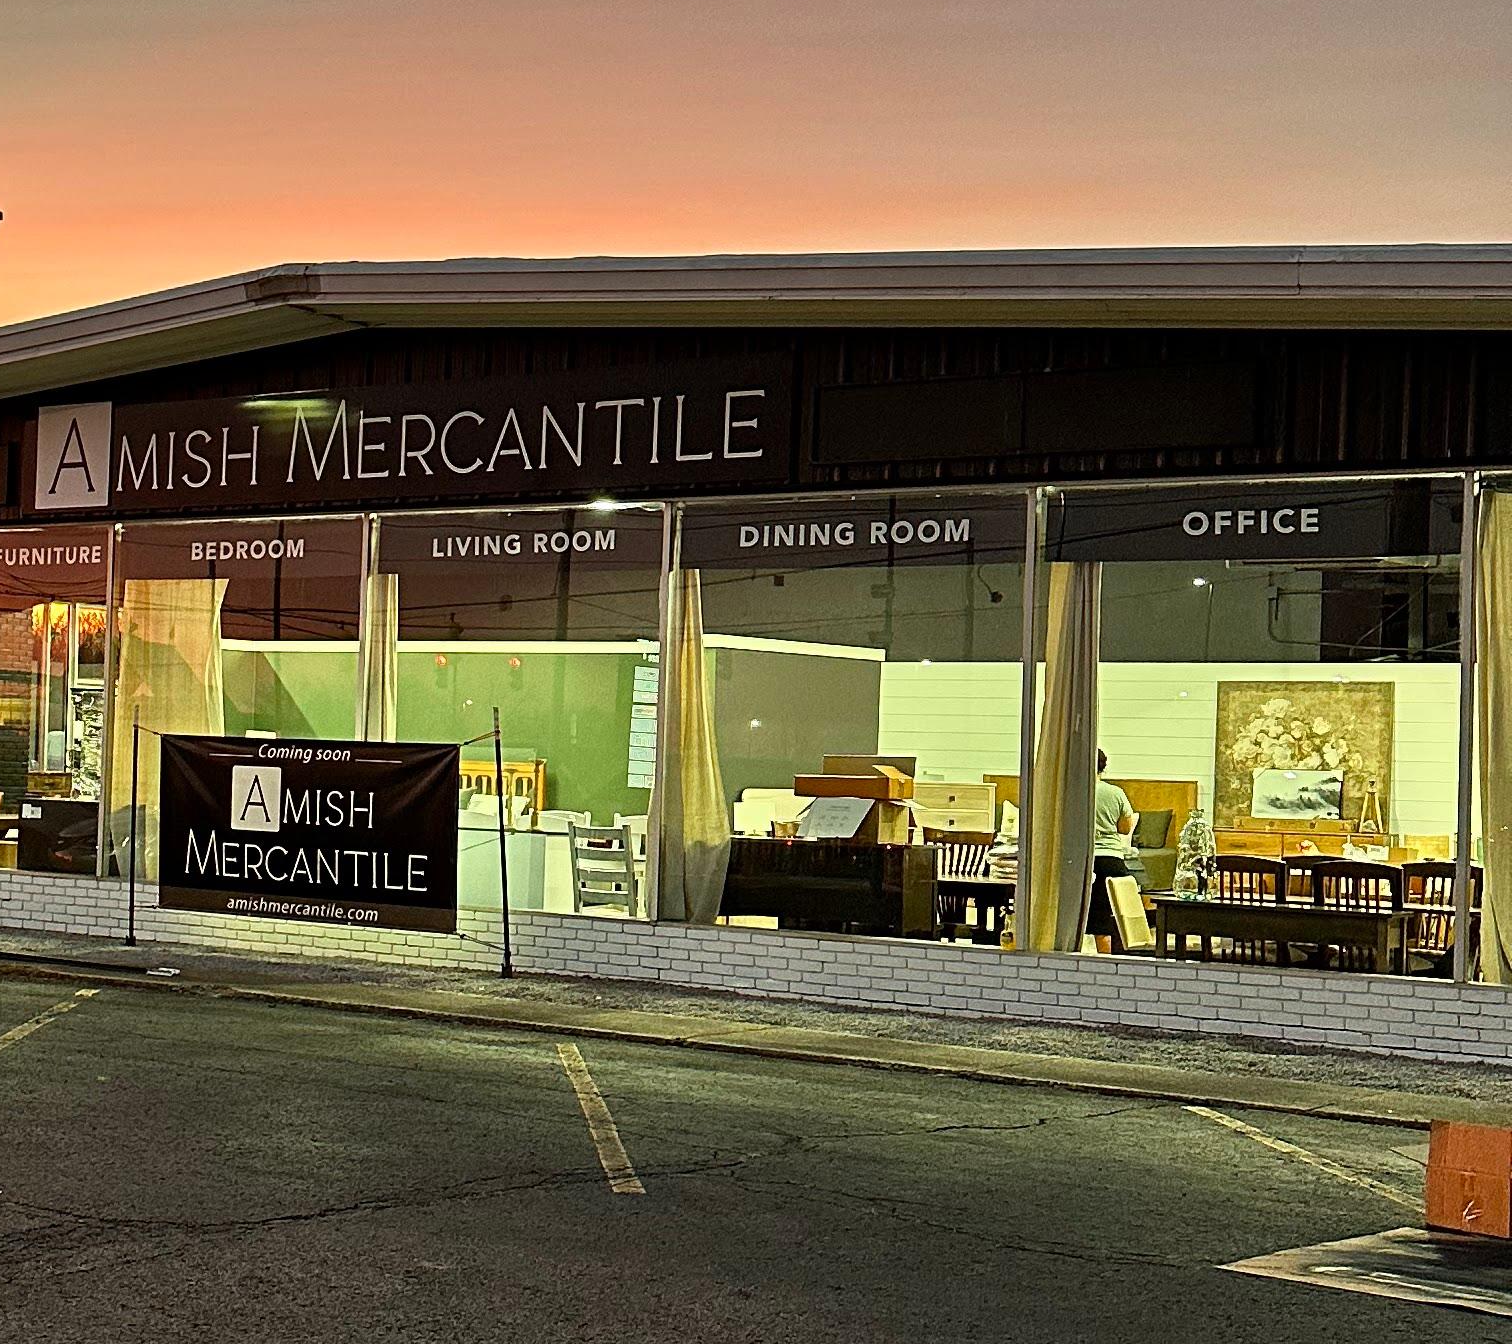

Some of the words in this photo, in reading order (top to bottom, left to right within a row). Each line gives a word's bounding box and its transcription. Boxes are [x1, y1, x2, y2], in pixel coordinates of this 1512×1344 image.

[48, 416, 260, 495] AMISH
[286, 389, 766, 484] MERCANTILE
[738, 522, 856, 548] DINING
[869, 518, 971, 545] ROOM
[1181, 508, 1320, 537] OFFICE
[190, 538, 305, 561] BEDROOM
[432, 534, 522, 558] LIVING
[533, 529, 616, 554] ROOM
[257, 743, 313, 764] Coming
[315, 748, 351, 762] soon
[239, 773, 375, 829] AMISH
[184, 828, 429, 893] MERCANTILE
[226, 896, 380, 923] amishmercantile.com
